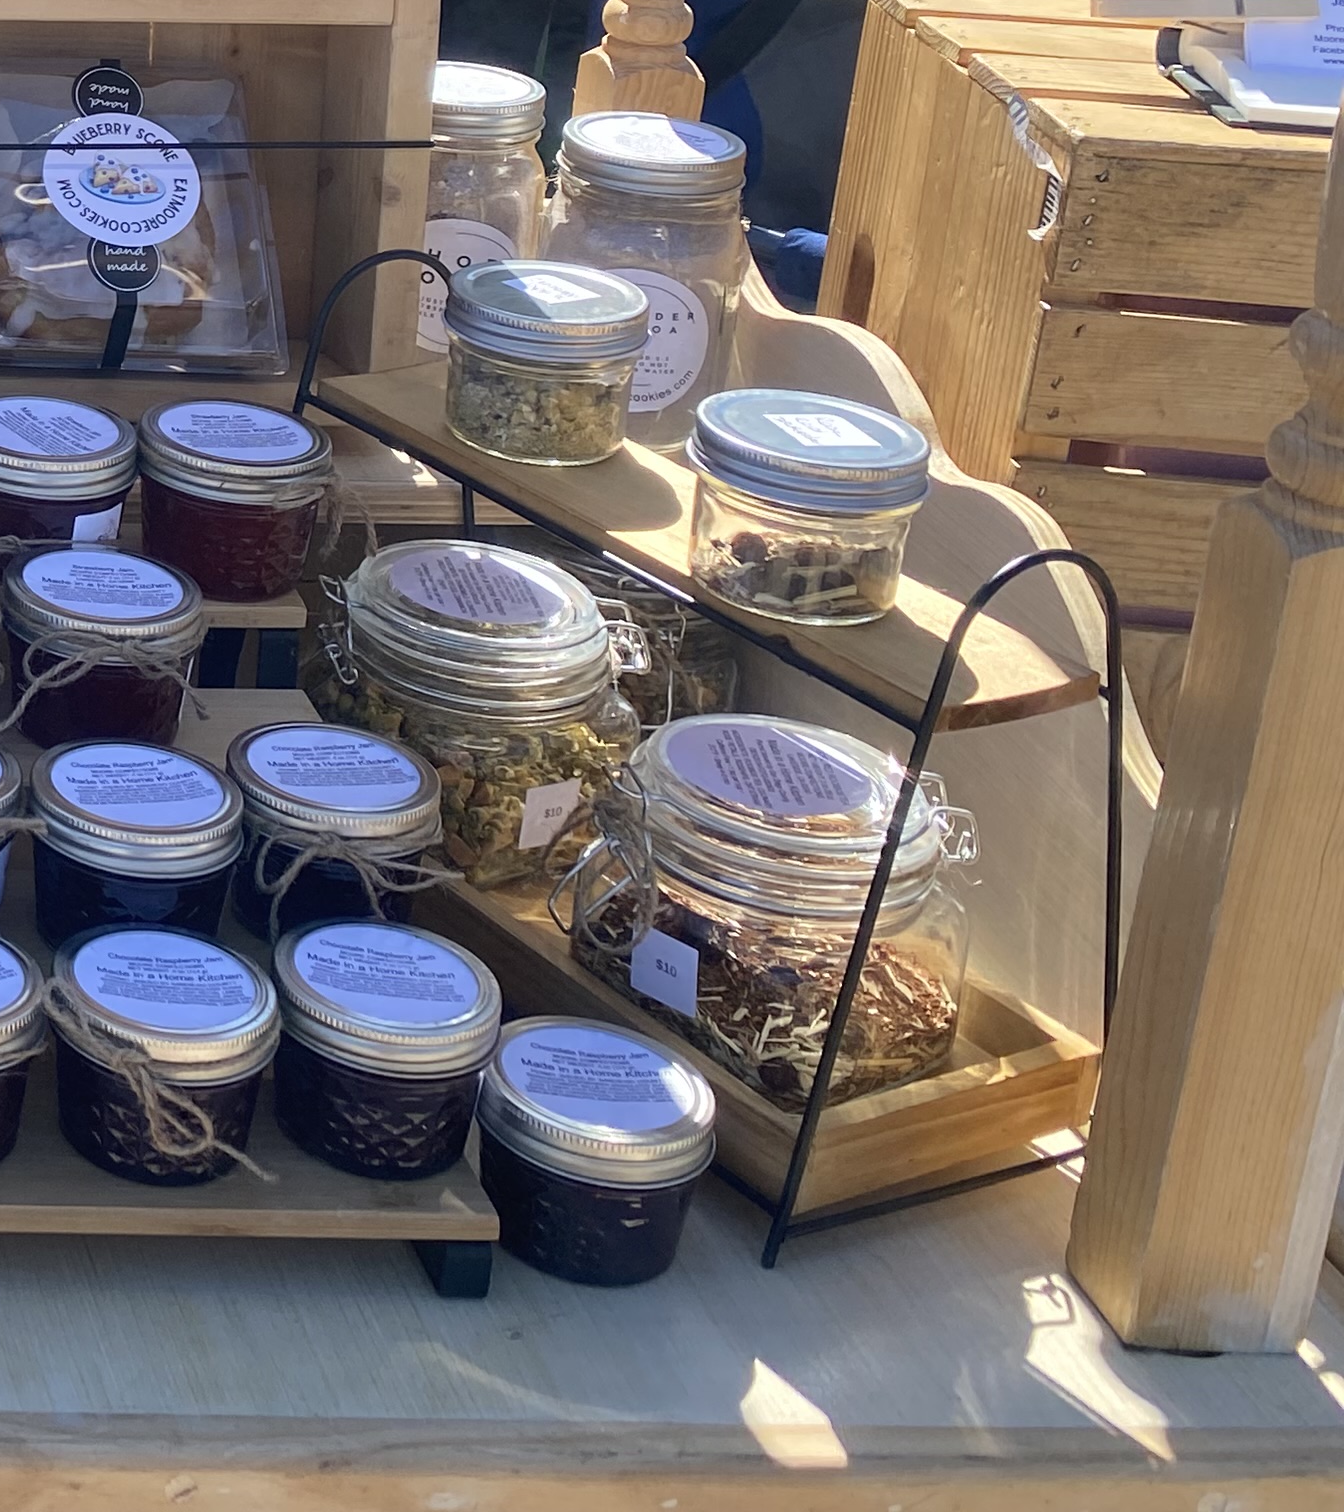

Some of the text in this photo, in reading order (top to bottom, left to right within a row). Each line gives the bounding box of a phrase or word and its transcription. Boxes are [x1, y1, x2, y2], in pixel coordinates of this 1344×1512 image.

[89, 82, 130, 95] made
[88, 97, 129, 112] hand
[57, 178, 188, 234] EATMOORECOOKIES.COM
[105, 245, 146, 257] hand
[107, 260, 148, 272] made
[544, 807, 562, 818] $10
[656, 958, 677, 978] $10
